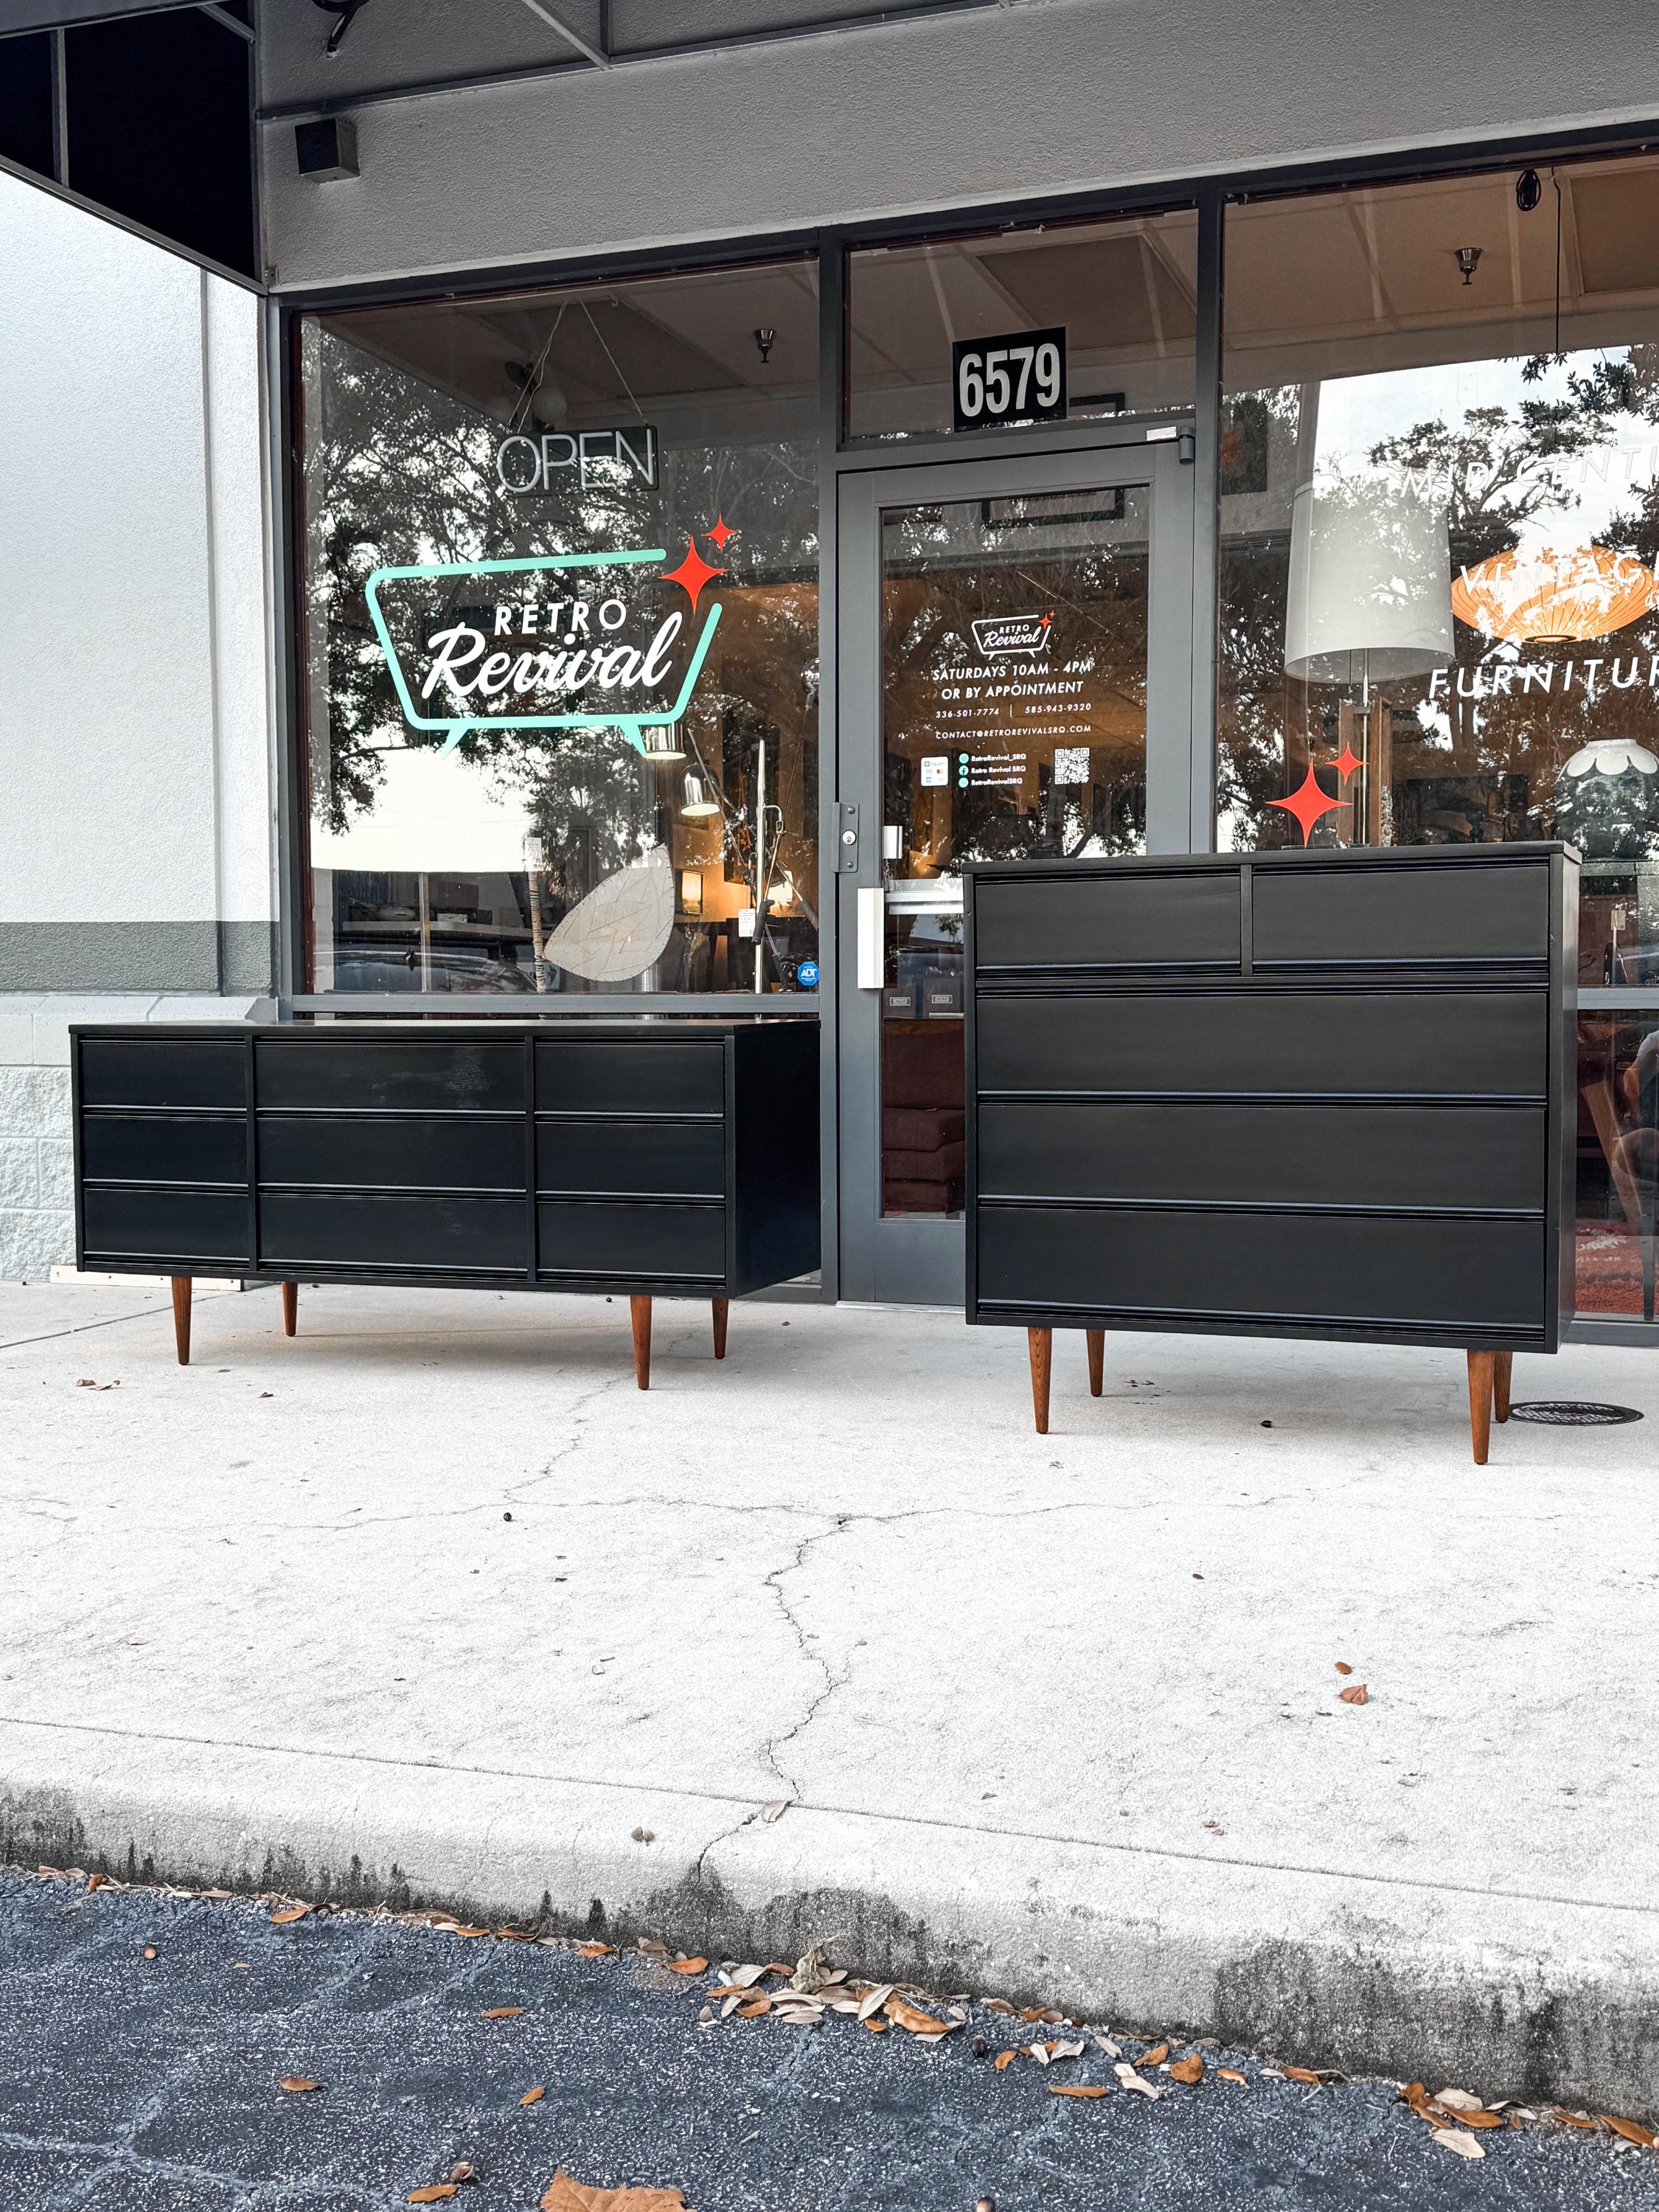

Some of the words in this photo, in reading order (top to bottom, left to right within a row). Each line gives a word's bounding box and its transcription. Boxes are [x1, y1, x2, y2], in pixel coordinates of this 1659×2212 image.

[959, 343, 1060, 417] 6579
[497, 428, 655, 493] OPEN
[494, 599, 627, 636] RETRO
[983, 626, 1041, 647] Revival
[999, 624, 1029, 634] RETRO
[421, 611, 684, 699] Revival
[932, 666, 1006, 681] SATURDAYS
[1012, 661, 1048, 676] 10AM
[1062, 660, 1091, 673] 4PM
[941, 688, 960, 700] OR
[965, 686, 981, 699] BY
[985, 681, 1084, 698] APPOINTMENT
[936, 708, 999, 718] 336-501-7774
[1024, 703, 1091, 714] 585-943-9320
[936, 725, 1091, 740] CONTACT@RETROREVIVALSRQ.COM
[971, 753, 1027, 762] RetroRevival_SRQ
[971, 777, 1023, 786] RetroRevivalSRQ
[801, 968, 817, 977] ADT
